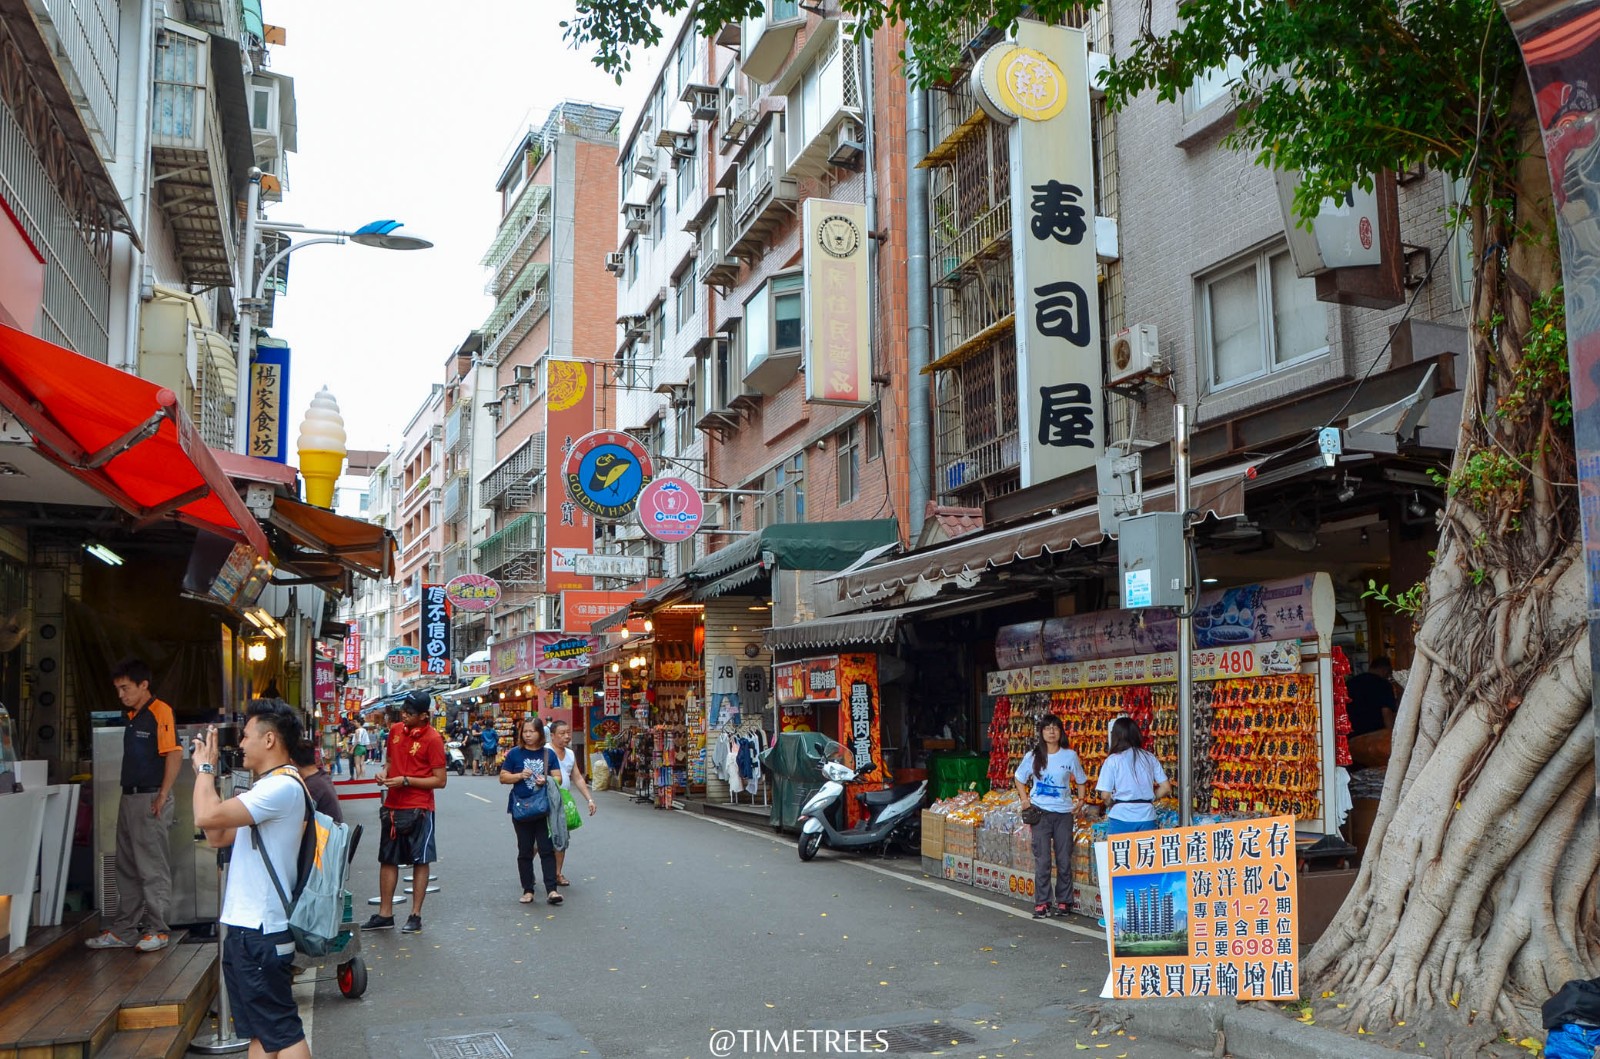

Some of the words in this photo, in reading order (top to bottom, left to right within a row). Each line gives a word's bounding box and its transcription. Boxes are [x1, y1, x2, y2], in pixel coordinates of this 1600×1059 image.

[253, 364, 276, 457] 楊家食坊
[568, 472, 606, 516] GOLDEN
[608, 502, 633, 517] HAT
[426, 585, 447, 674] 信不信由你
[543, 643, 560, 653] IT'S
[560, 639, 588, 650] SUPER
[543, 645, 593, 659] SPARKLING!
[718, 665, 735, 679] 78
[1219, 650, 1254, 674] 480
[604, 672, 622, 718] 甘蔗汁
[746, 680, 761, 692] 68
[1111, 821, 1291, 872] 買房置產勝定存
[1191, 863, 1291, 898] 海洋都心
[1193, 917, 1292, 938] 三房含車位
[1194, 937, 1292, 957] 只要698萬
[1115, 960, 1295, 998] 存錢買房輸增值
